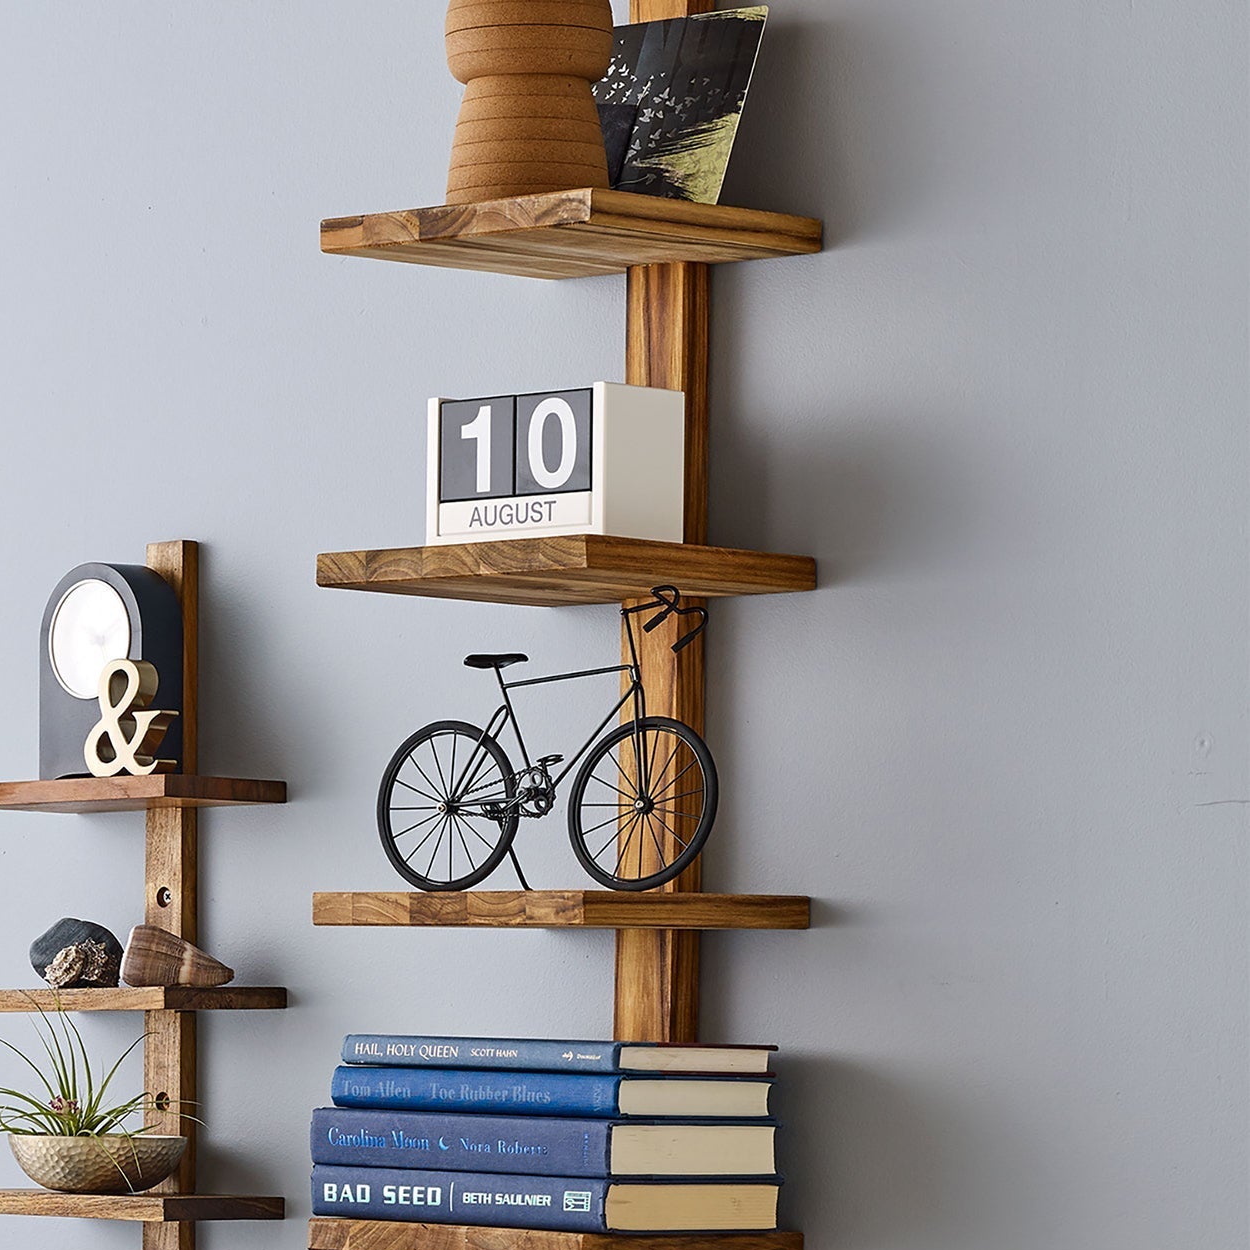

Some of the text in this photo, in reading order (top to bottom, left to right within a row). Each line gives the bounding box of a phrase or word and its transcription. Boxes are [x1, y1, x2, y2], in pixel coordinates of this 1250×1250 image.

[461, 397, 577, 494] 10
[468, 500, 557, 528] AUGUST
[84, 658, 174, 778] &
[354, 1042, 519, 1060] HAIL, HOLY QUEEN SCOTT HAHN
[341, 1080, 551, 1104] Tom Allen Toe Rubber Blues
[328, 1126, 548, 1156] Carolina Moon Nora Roberts
[323, 1183, 551, 1207] BAD SEED BETH SAULNIER
